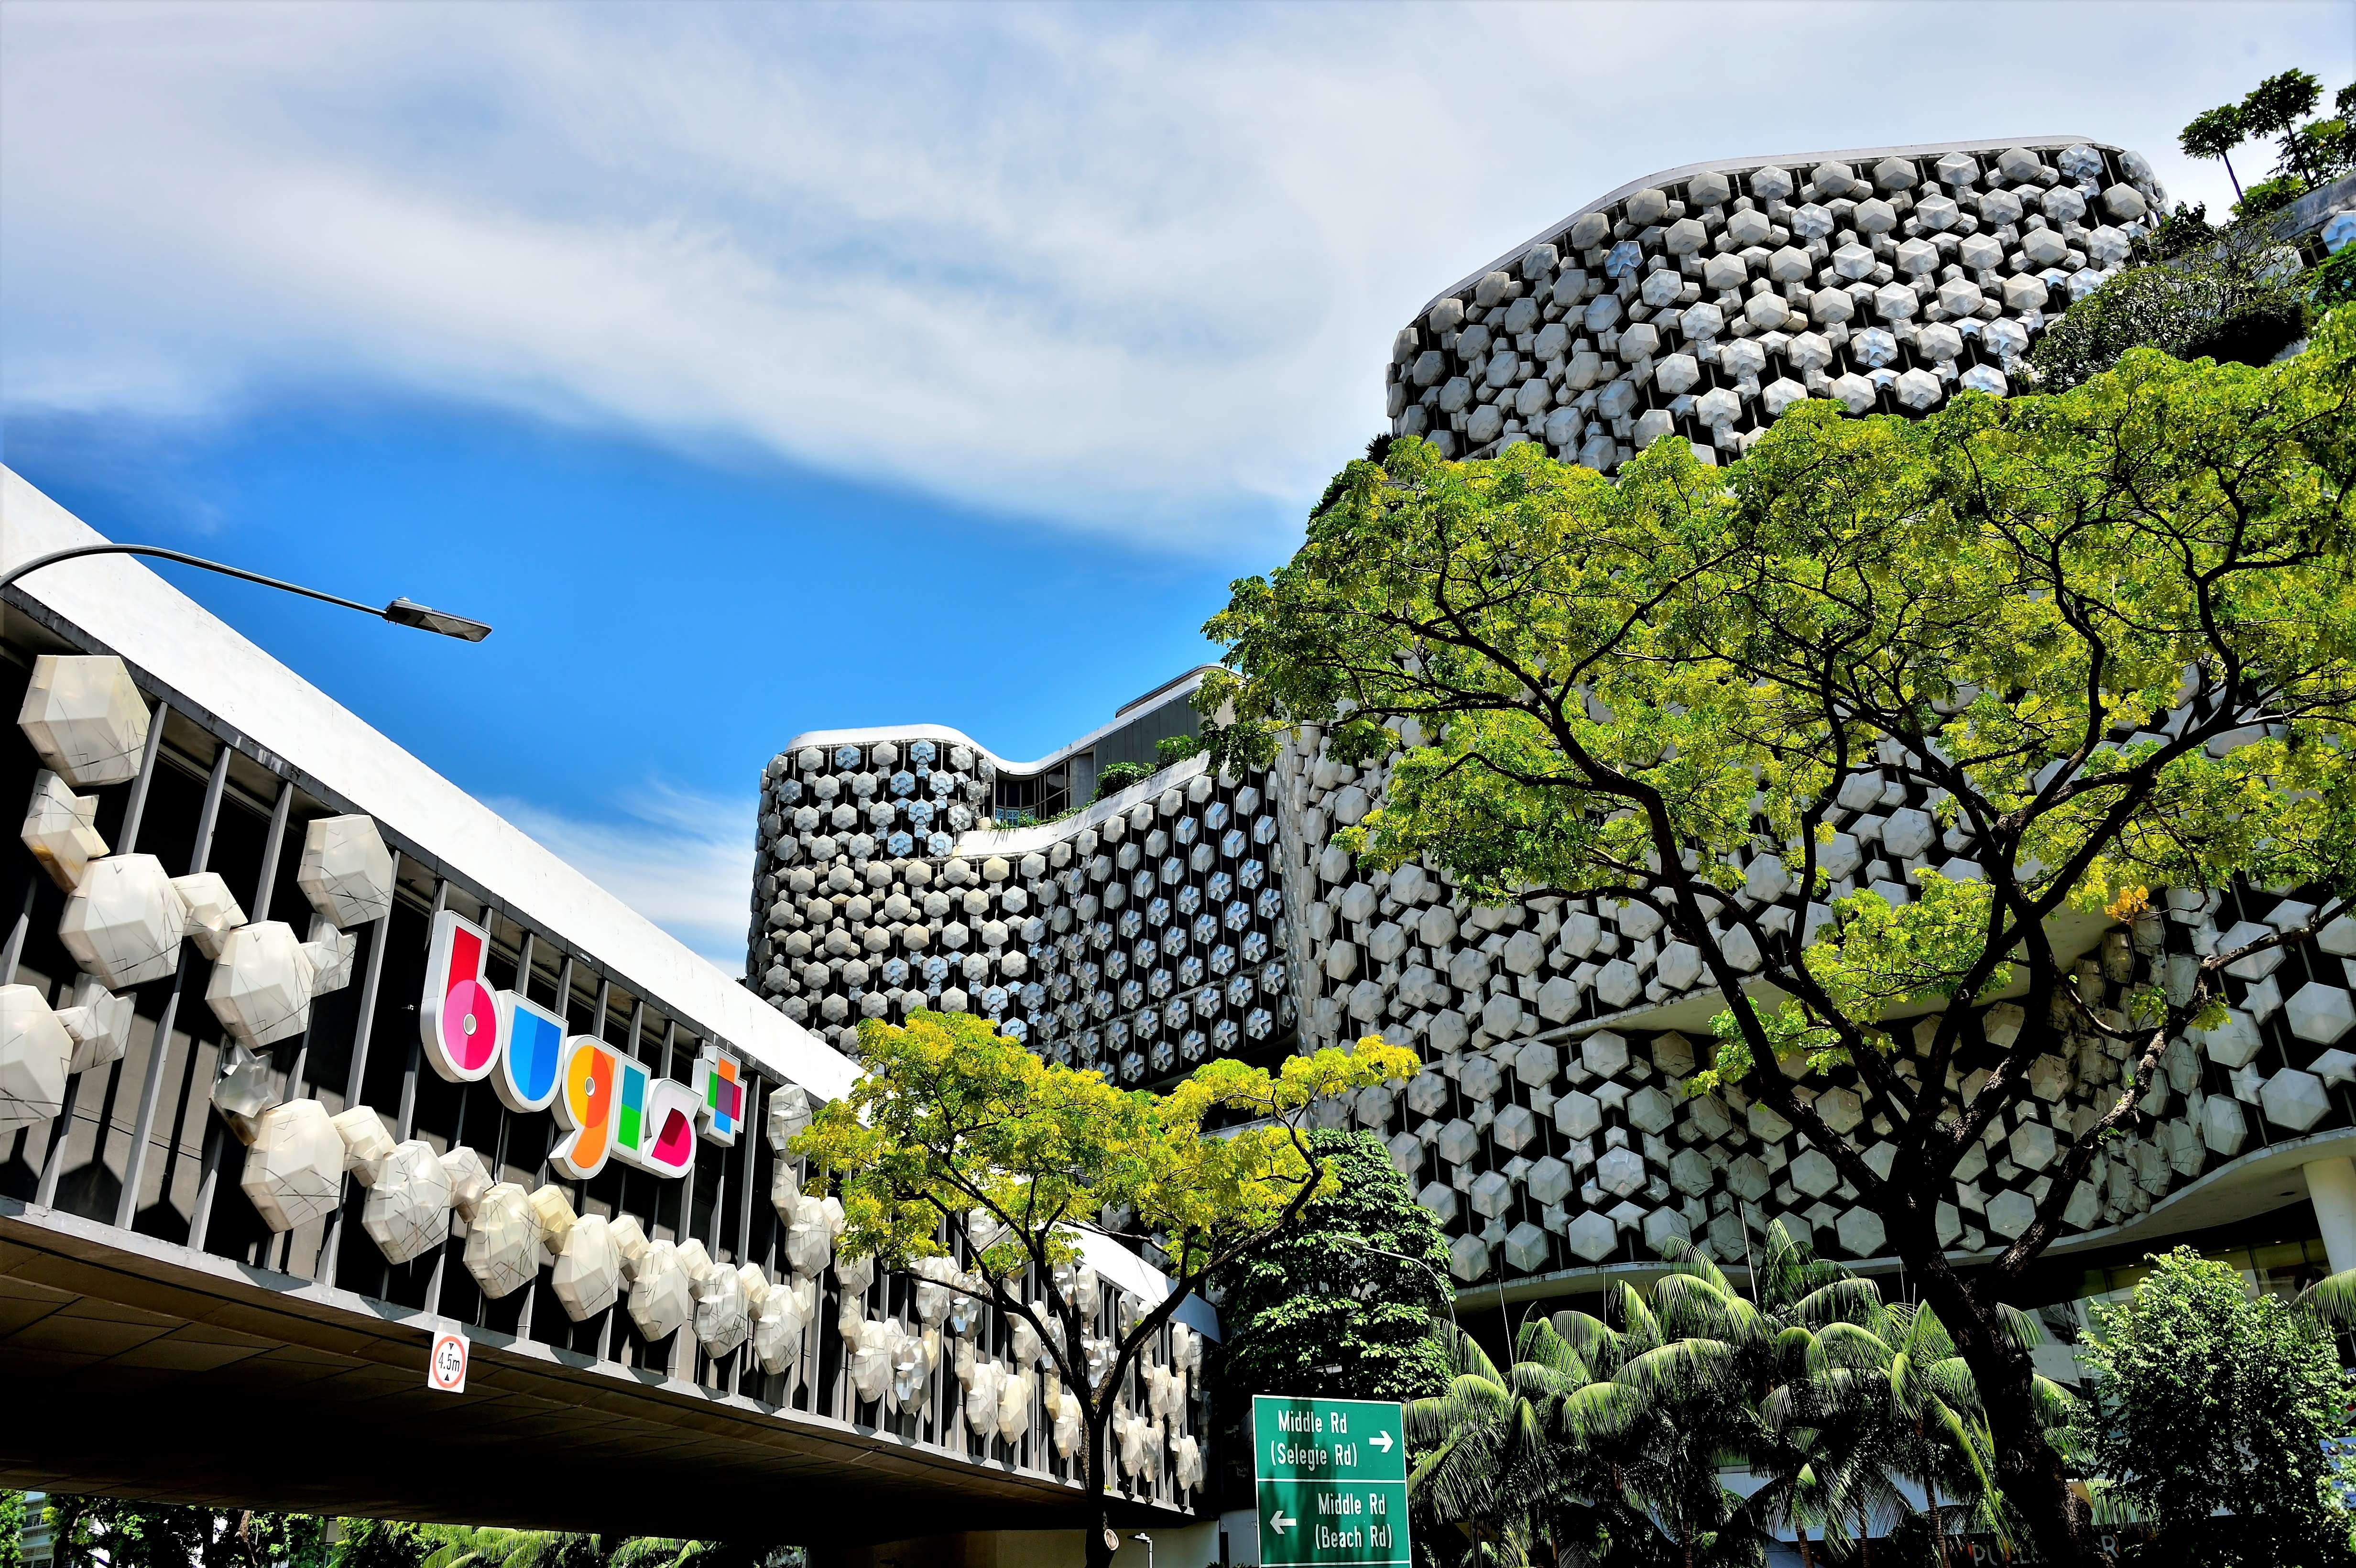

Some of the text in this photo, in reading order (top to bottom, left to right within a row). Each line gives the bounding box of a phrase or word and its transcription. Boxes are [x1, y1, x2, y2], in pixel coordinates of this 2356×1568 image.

[438, 1352, 460, 1372] 4.5m
[1278, 1410, 1347, 1434] Middle Rd
[1271, 1440, 1357, 1471] (Selegie Rd)
[1318, 1493, 1385, 1514] Middle Rd
[1315, 1524, 1392, 1550] (Beach Rd)
